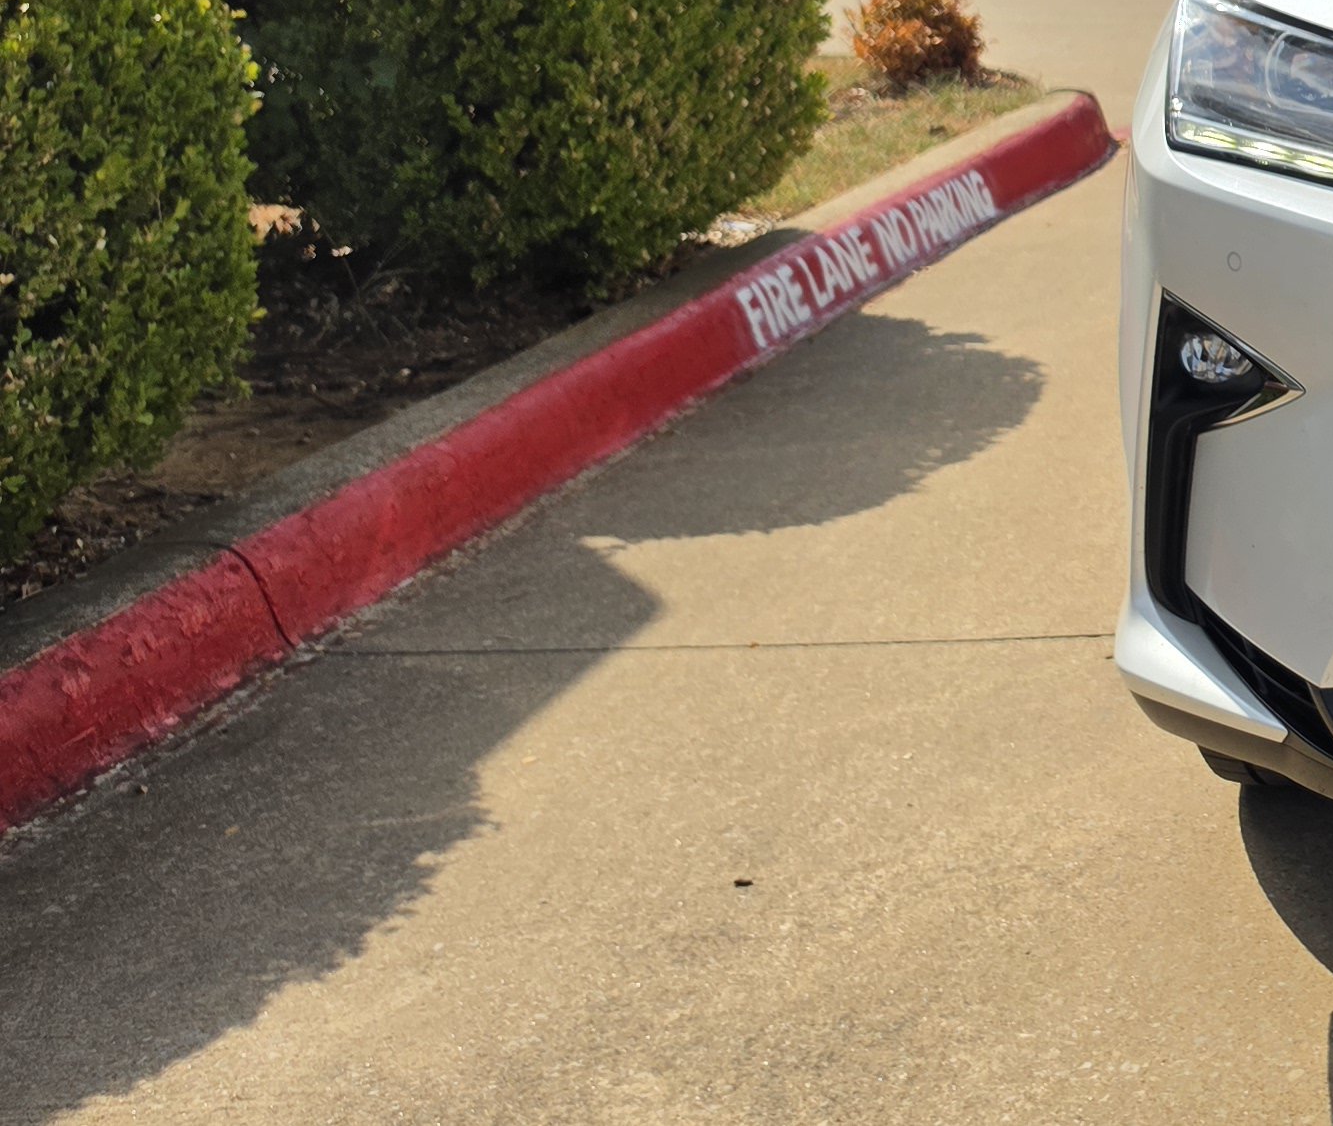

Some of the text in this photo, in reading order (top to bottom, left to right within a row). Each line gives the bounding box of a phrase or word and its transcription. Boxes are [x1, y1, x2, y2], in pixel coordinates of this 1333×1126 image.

[736, 169, 998, 349] FIRE LANE NO PARKING
